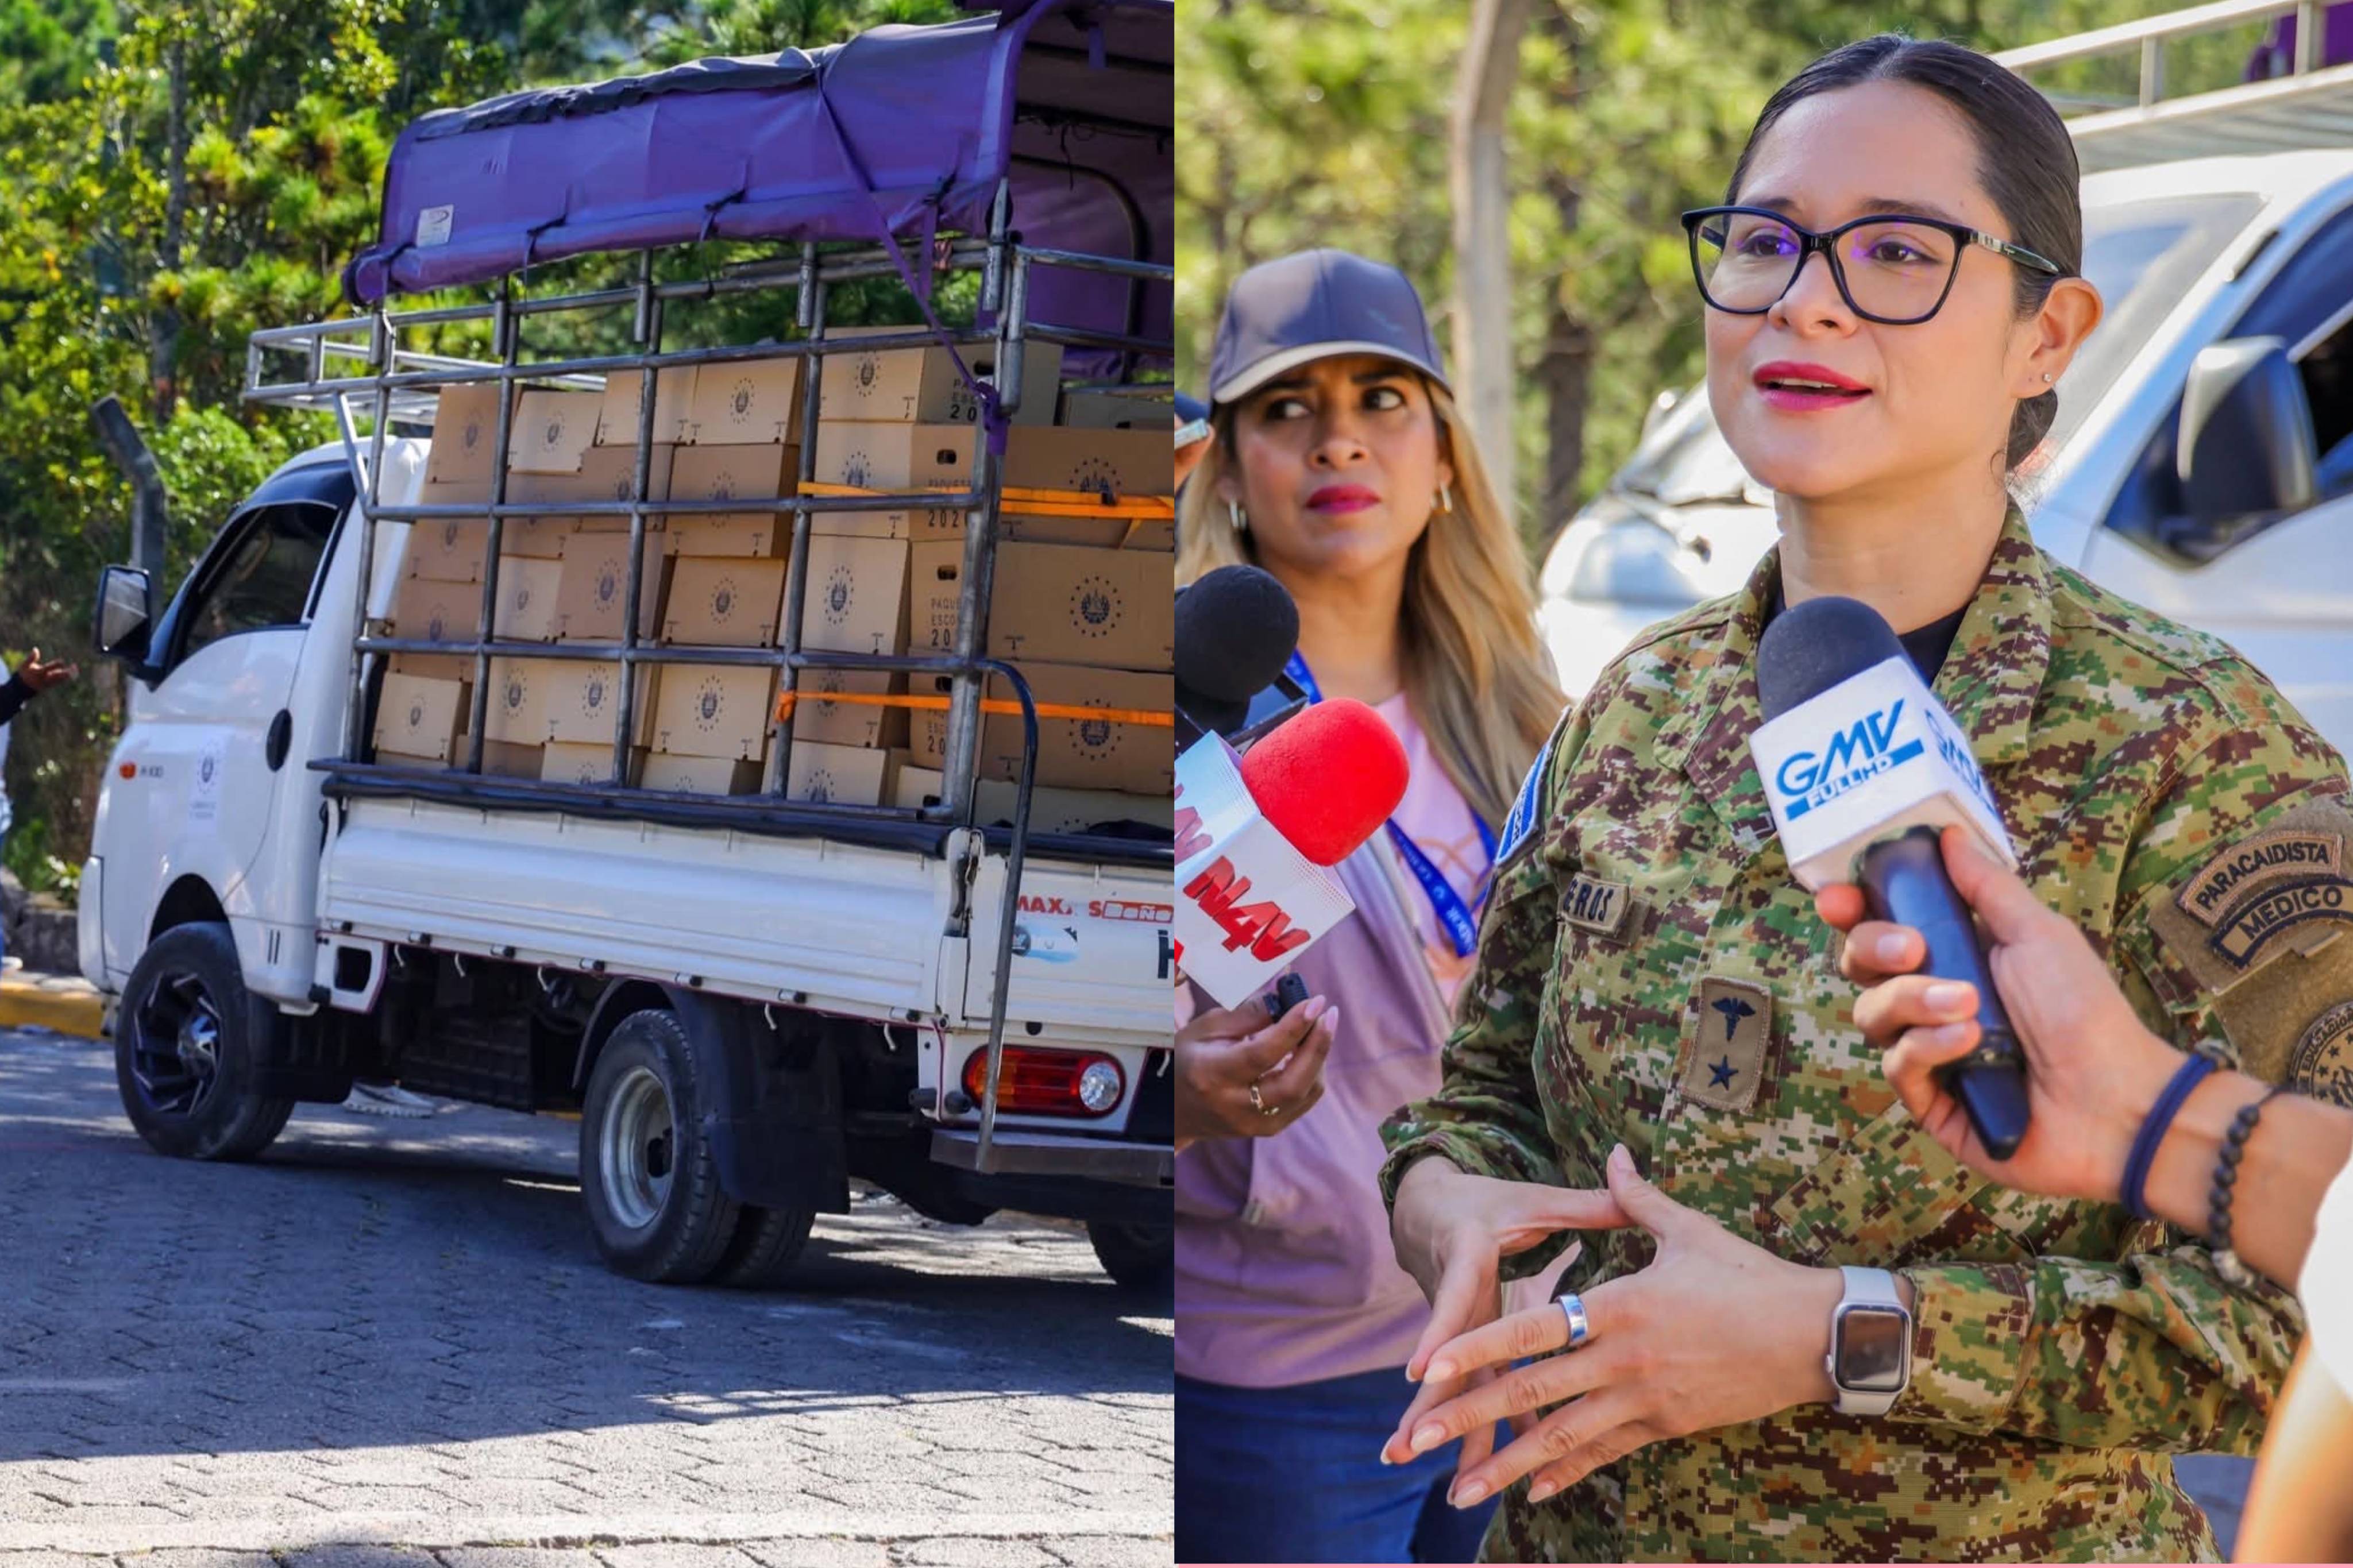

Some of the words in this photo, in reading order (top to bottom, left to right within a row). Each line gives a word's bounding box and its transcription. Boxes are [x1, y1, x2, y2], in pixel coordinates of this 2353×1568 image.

[950, 404, 977, 422] 20
[928, 509, 969, 527] 202
[931, 613, 956, 627] ESCO
[931, 628, 951, 647] 20
[928, 735, 946, 756] 20
[2195, 841, 2329, 910] PARACAIDISTA
[2238, 885, 2343, 941] MEDICO
